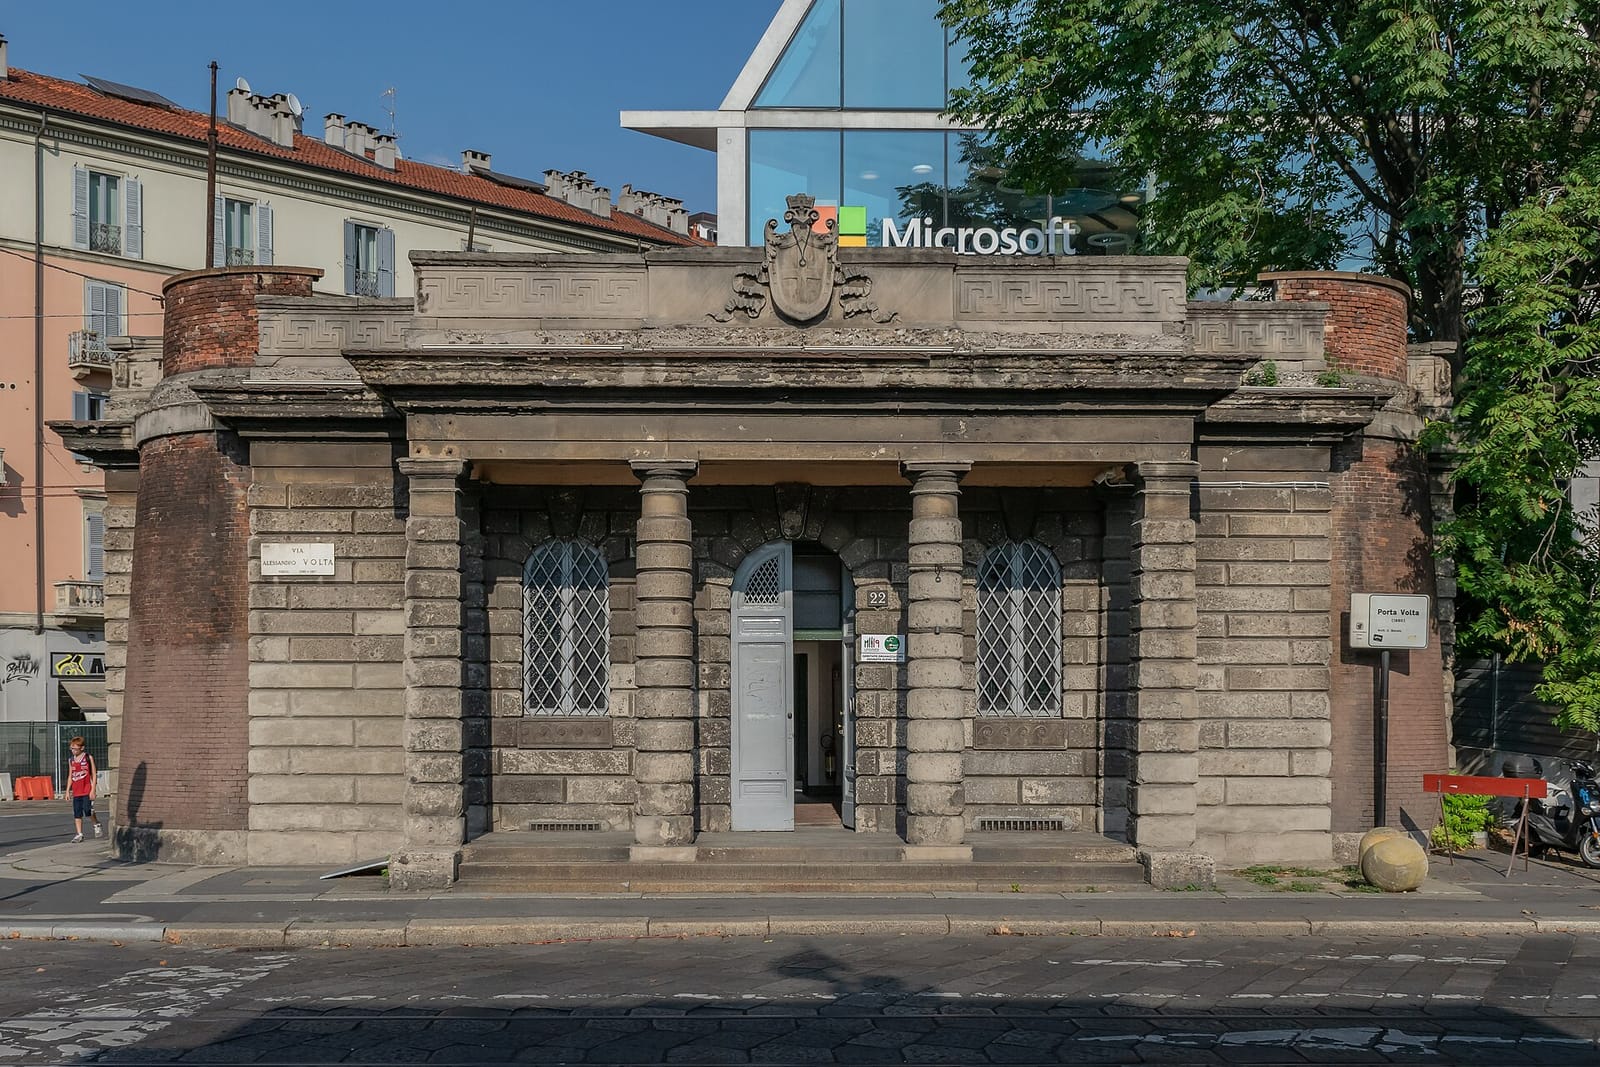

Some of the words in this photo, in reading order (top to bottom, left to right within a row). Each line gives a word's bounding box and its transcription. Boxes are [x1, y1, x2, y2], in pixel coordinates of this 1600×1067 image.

[882, 216, 1076, 255] Microsoft
[303, 558, 333, 566] VOLTA
[870, 592, 886, 604] 22
[1377, 608, 1397, 616] Porta
